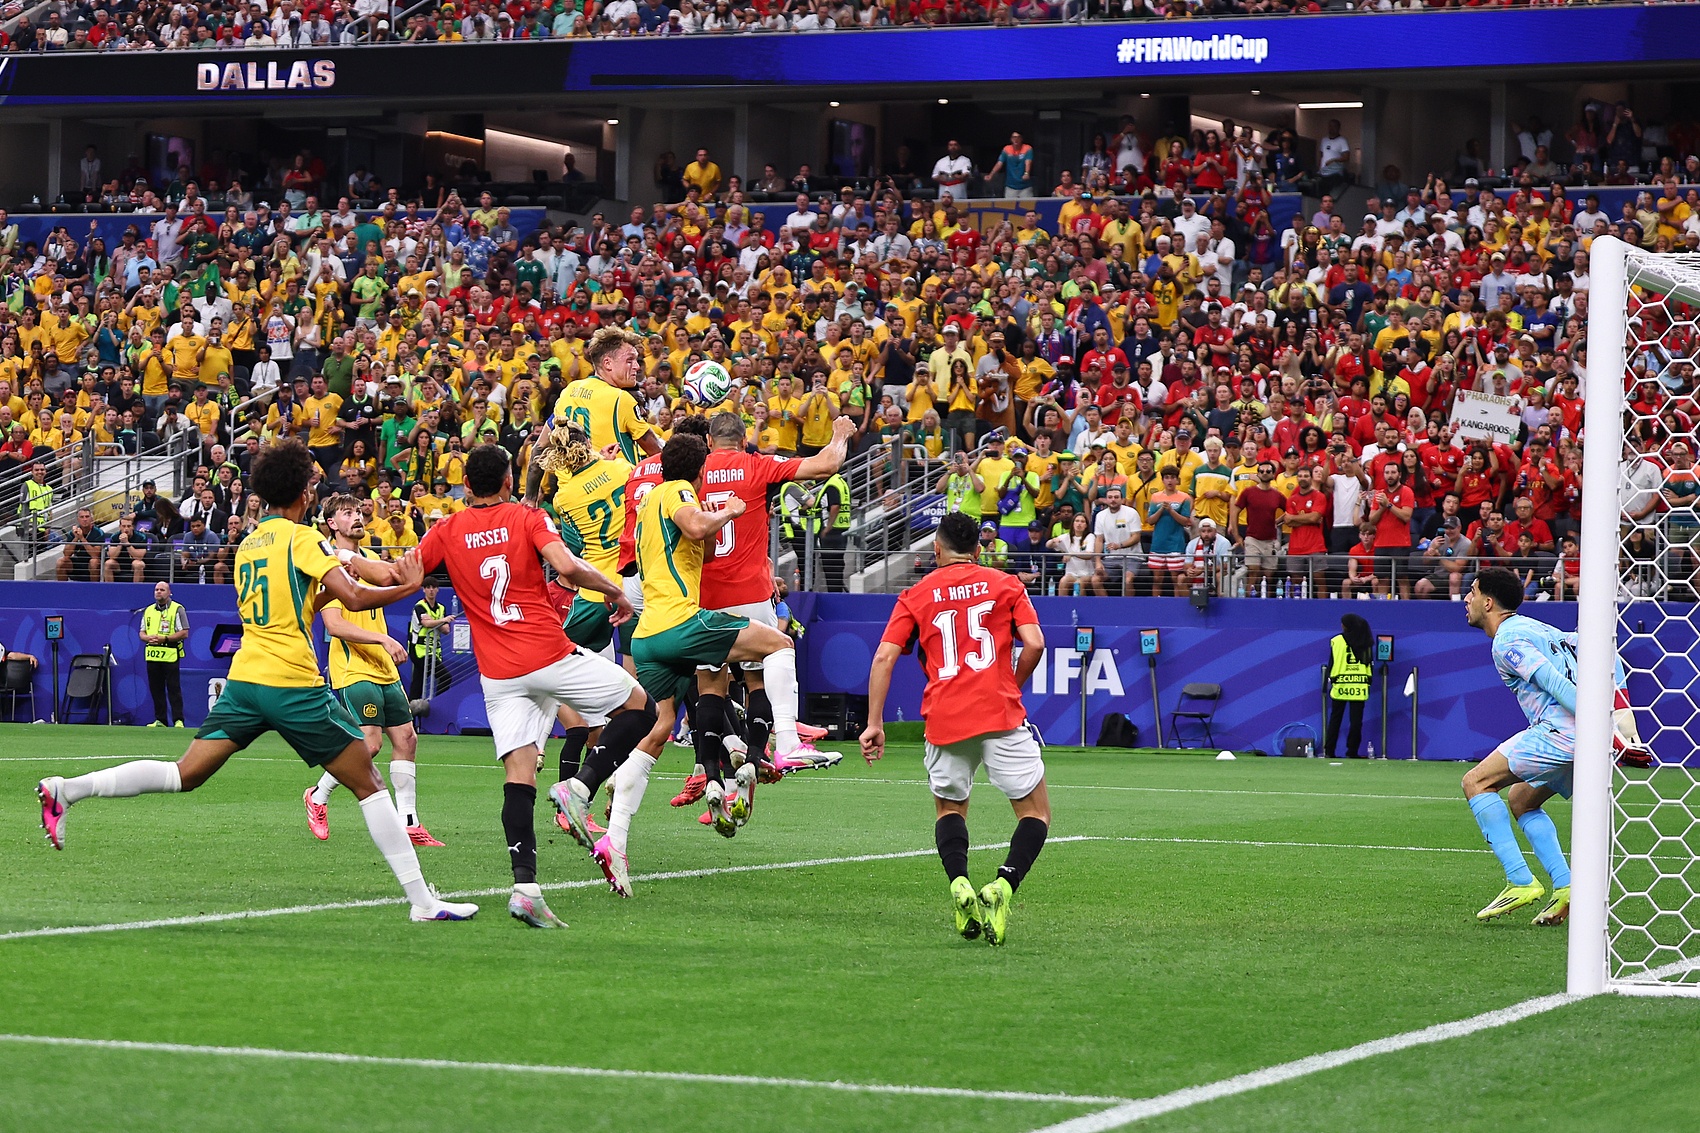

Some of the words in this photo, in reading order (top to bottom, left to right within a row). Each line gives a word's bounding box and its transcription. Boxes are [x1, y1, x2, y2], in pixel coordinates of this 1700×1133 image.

[1117, 35, 1268, 63] #FIFAWorldCup
[197, 60, 335, 90] DALLAS
[1466, 391, 1511, 406] PHARAOHS
[1461, 419, 1510, 434] KANGAROOS
[583, 471, 612, 494] IRVINE
[923, 508, 946, 516] WORL
[465, 527, 509, 549] YASSER
[240, 558, 270, 626] 25
[480, 554, 525, 626] 2
[932, 588, 946, 603] K.
[948, 581, 989, 601] HAFEZ
[48, 624, 59, 633] 05
[932, 600, 996, 680] 15
[1079, 635, 1089, 645] 01
[1143, 637, 1155, 647] 04
[1379, 644, 1389, 653] 03
[1338, 687, 1367, 696] 04031
